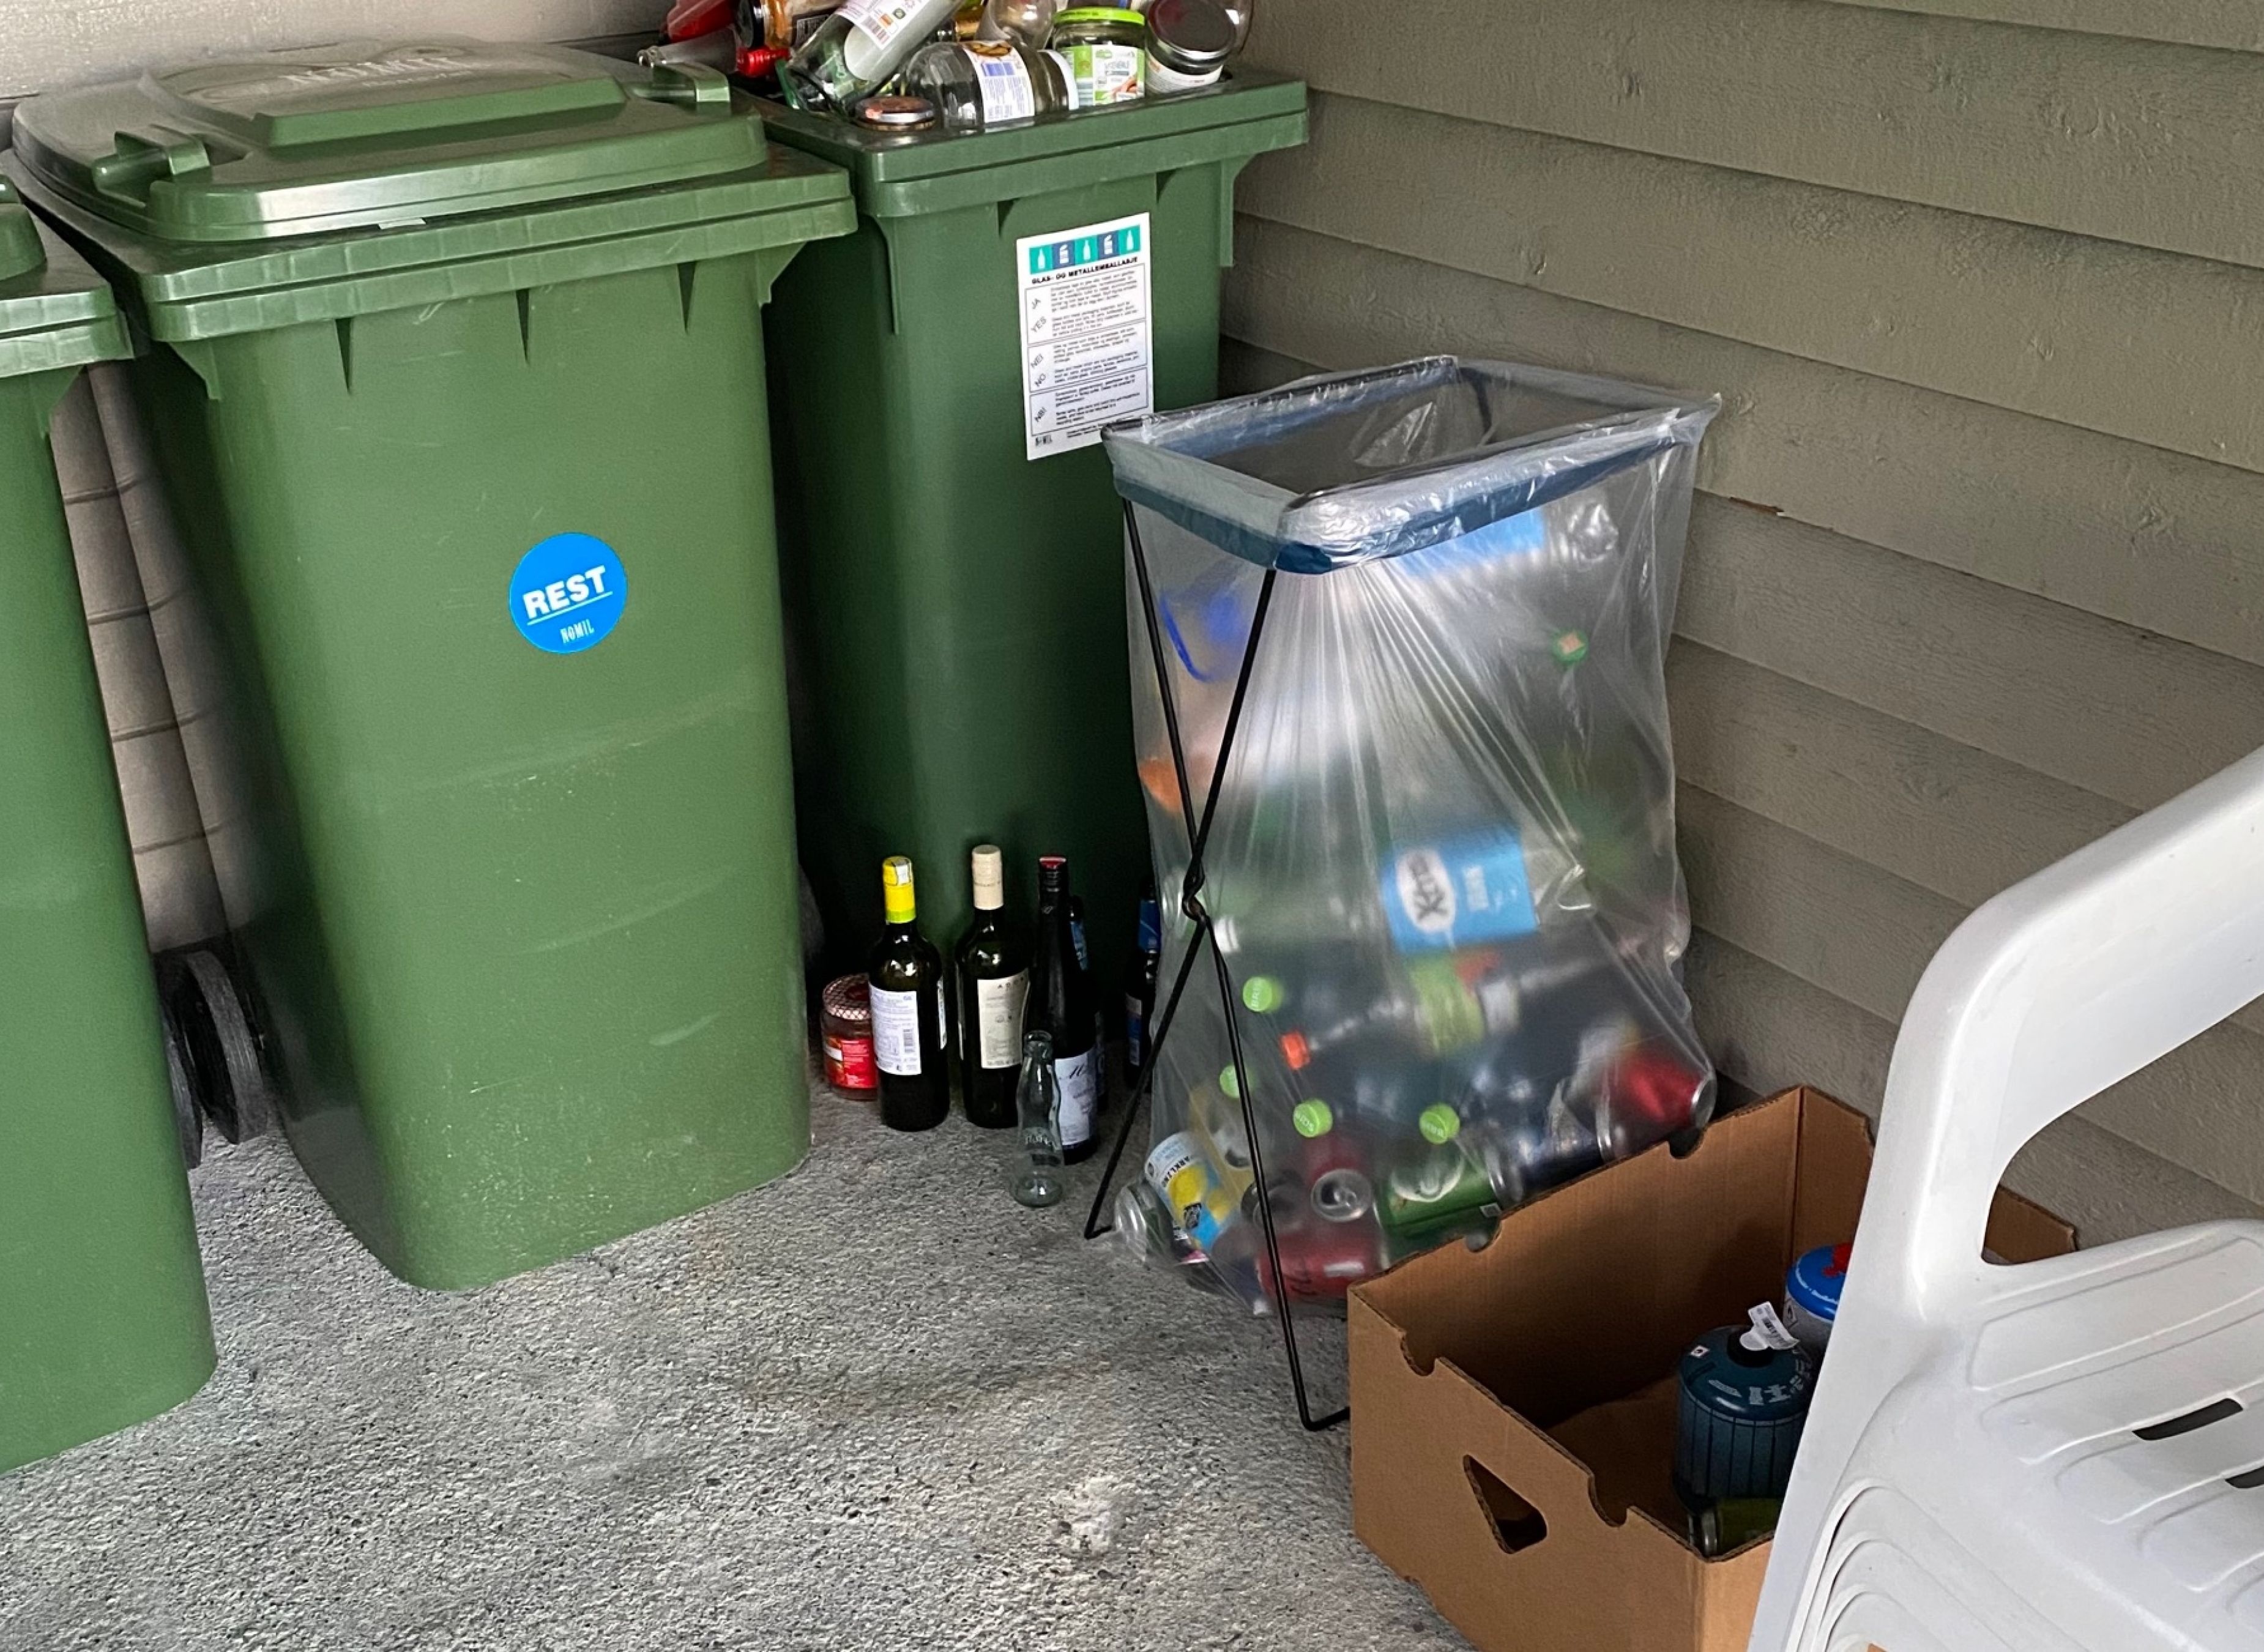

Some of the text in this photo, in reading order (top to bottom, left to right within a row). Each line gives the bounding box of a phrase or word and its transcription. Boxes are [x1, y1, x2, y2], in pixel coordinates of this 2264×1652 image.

[1068, 256, 1138, 277] METALLEMBALLASJE
[1031, 298, 1041, 309] JA
[1031, 316, 1047, 333] YES
[1030, 353, 1044, 368] NEI
[1034, 373, 1046, 387] NO
[523, 565, 606, 619] REST
[560, 619, 595, 644] NOMIL
